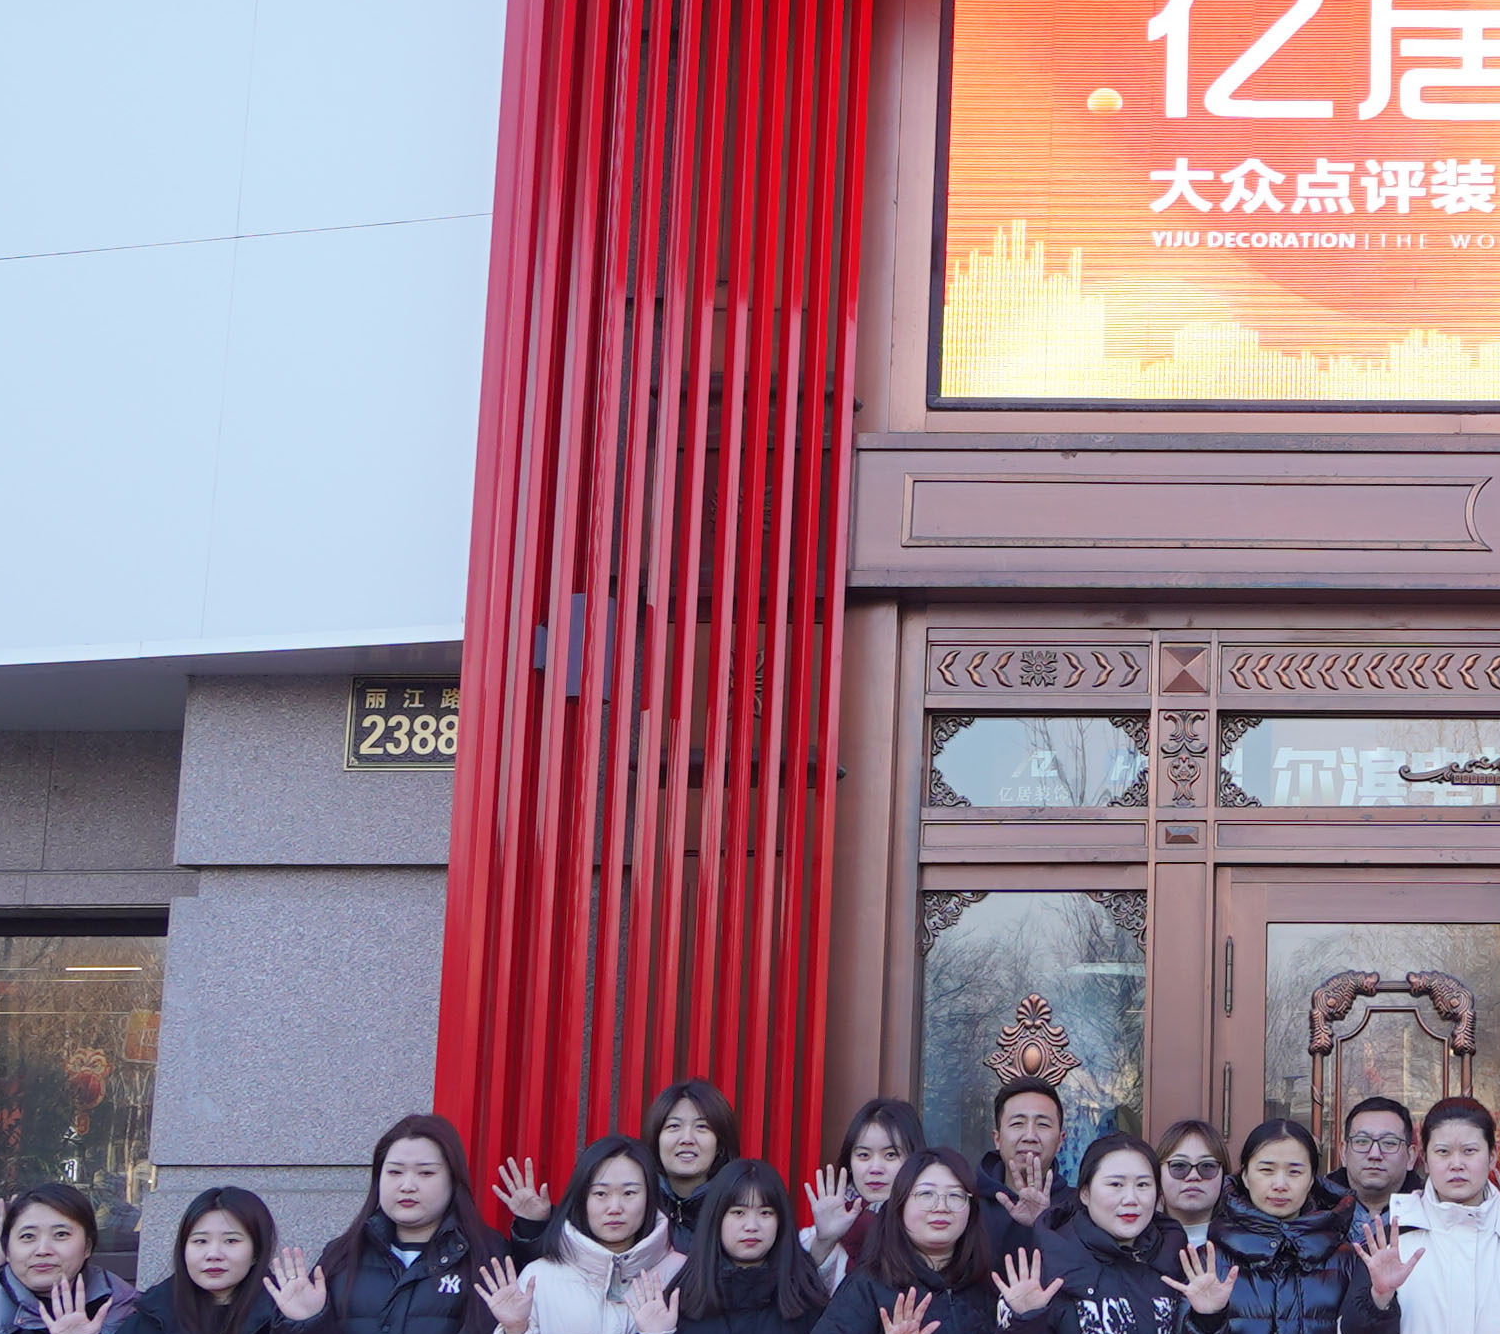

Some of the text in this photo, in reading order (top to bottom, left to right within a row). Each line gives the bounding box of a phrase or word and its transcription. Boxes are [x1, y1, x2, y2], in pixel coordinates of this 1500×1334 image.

[1151, 230, 1200, 249] YIJU
[1206, 230, 1357, 250] DECORATION
[1380, 232, 1429, 250] THE
[365, 688, 460, 709] 丽江路
[360, 714, 459, 755] 2388
